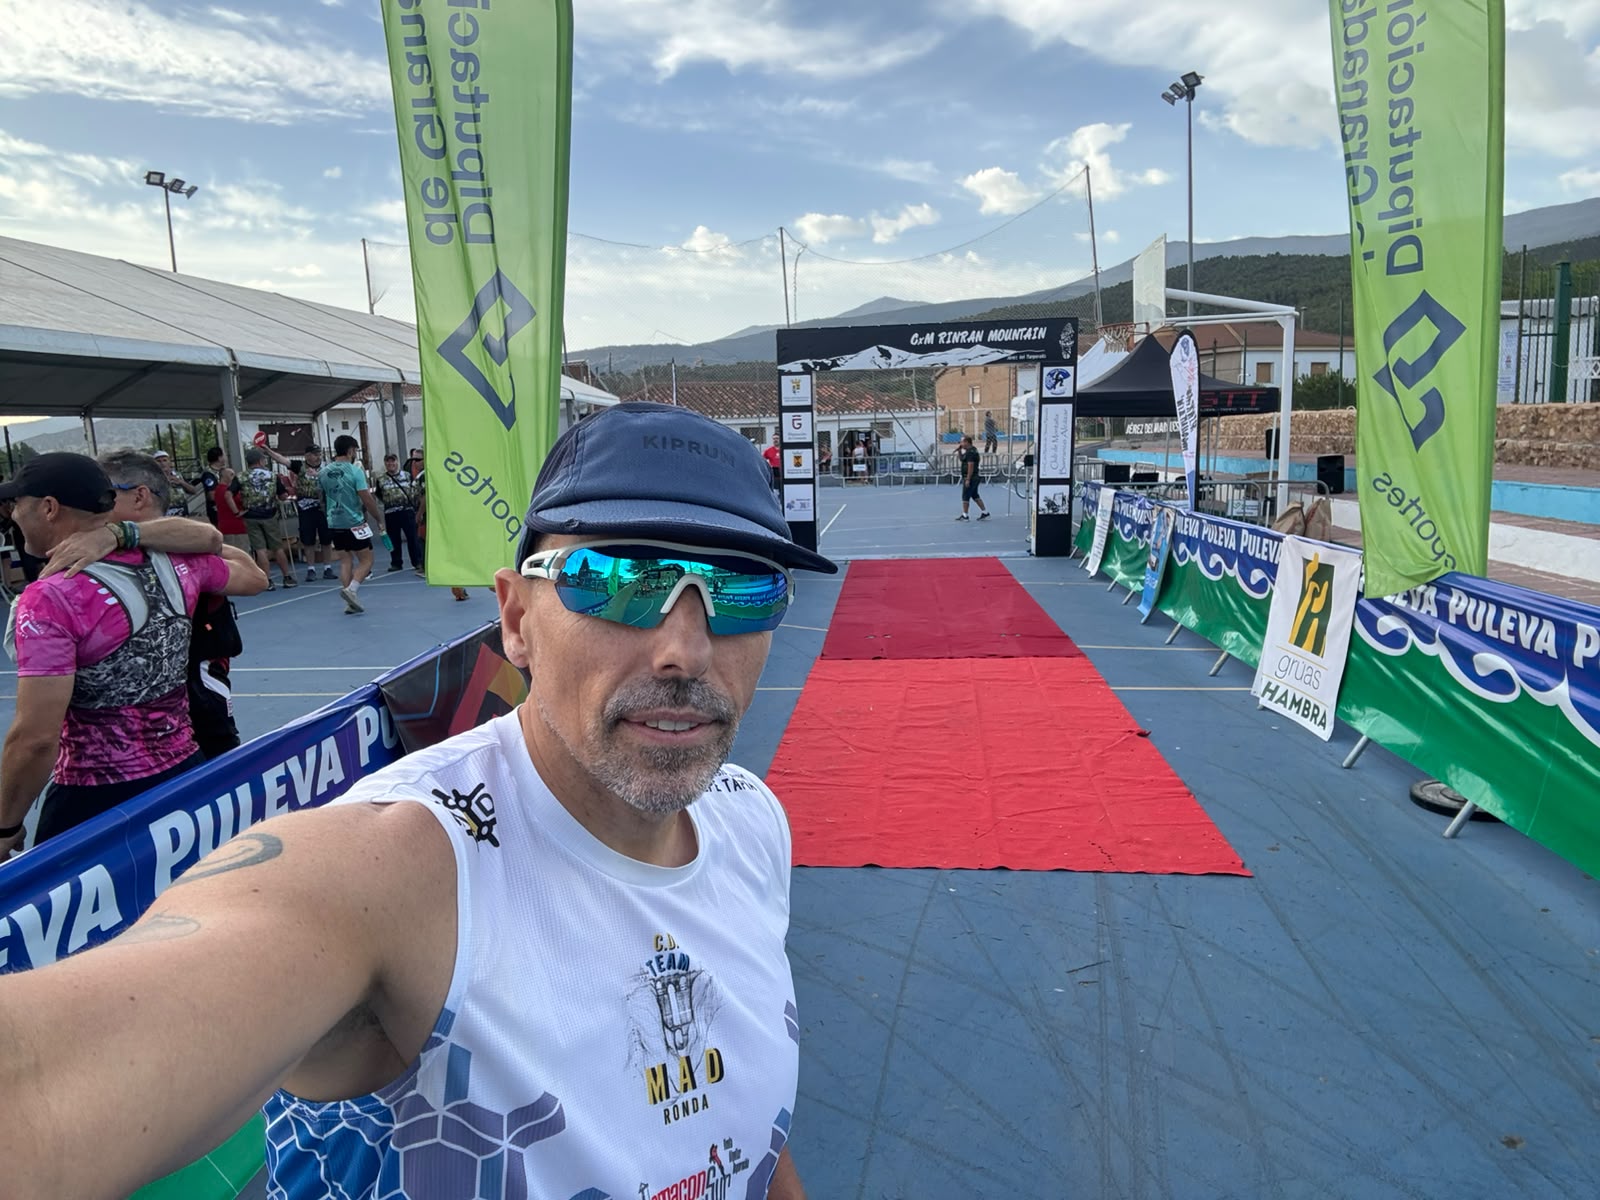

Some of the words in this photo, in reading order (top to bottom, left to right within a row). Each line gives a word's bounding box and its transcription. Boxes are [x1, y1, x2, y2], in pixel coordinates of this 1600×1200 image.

[938, 330, 984, 345] RINRAN
[987, 326, 1048, 343] MOUNTAIN
[643, 435, 736, 468] KIPRUN
[1201, 519, 1236, 551] PULEVA
[1449, 587, 1559, 660] PULEVA
[1260, 681, 1327, 731] HAMBRA
[149, 736, 345, 898] PULEVA
[646, 952, 691, 977] TEAM
[663, 1093, 709, 1126] RONDA
